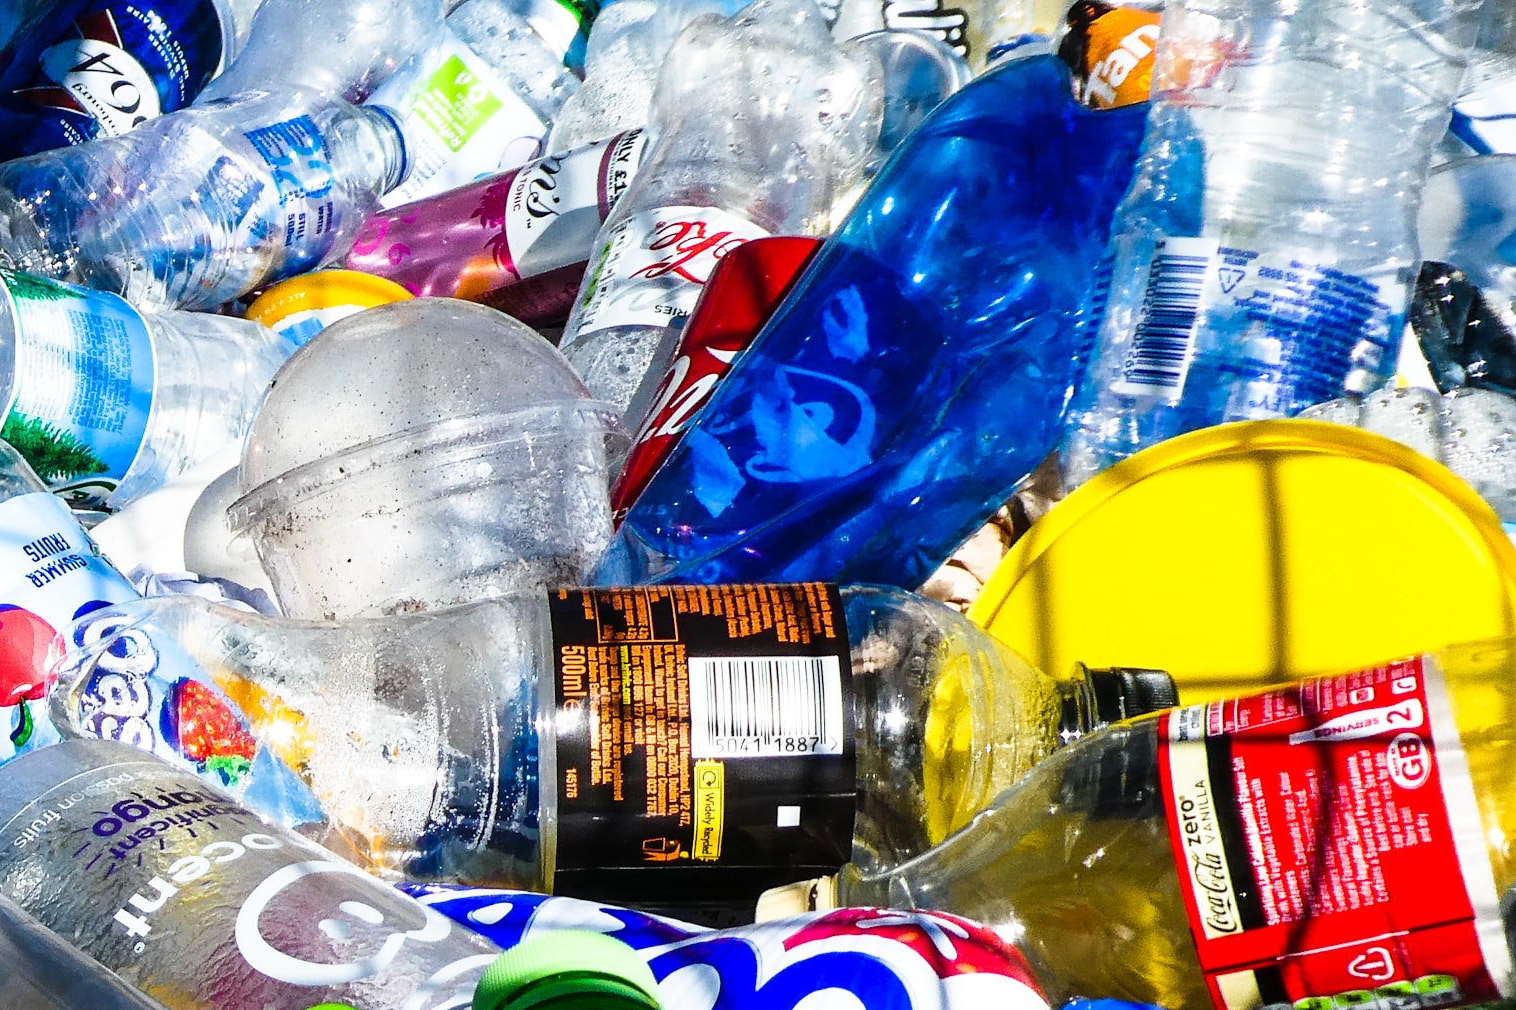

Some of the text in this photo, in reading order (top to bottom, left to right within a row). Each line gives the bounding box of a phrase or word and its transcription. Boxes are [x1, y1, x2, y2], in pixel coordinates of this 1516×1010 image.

[1082, 23, 1163, 107] Tan
[512, 170, 530, 212] TONIC
[294, 212, 306, 241] STILL
[21, 529, 71, 565] FRUITS
[24, 550, 89, 591] SUMMER
[560, 645, 585, 697] 500ml
[1385, 702, 1413, 727] 2
[667, 738, 677, 753] Box
[714, 736, 820, 753] 5041 1887
[1401, 736, 1424, 781] GB
[565, 767, 577, 798] 145176
[656, 747, 667, 815] Call our Consumer
[668, 777, 678, 802] Dublin
[11, 806, 62, 850] fruits
[701, 792, 715, 857] Widely Recycled
[1178, 794, 1201, 847] zero
[1194, 778, 1216, 845] VANILLA
[1249, 777, 1273, 835] Extracts with
[114, 826, 285, 939] ocent
